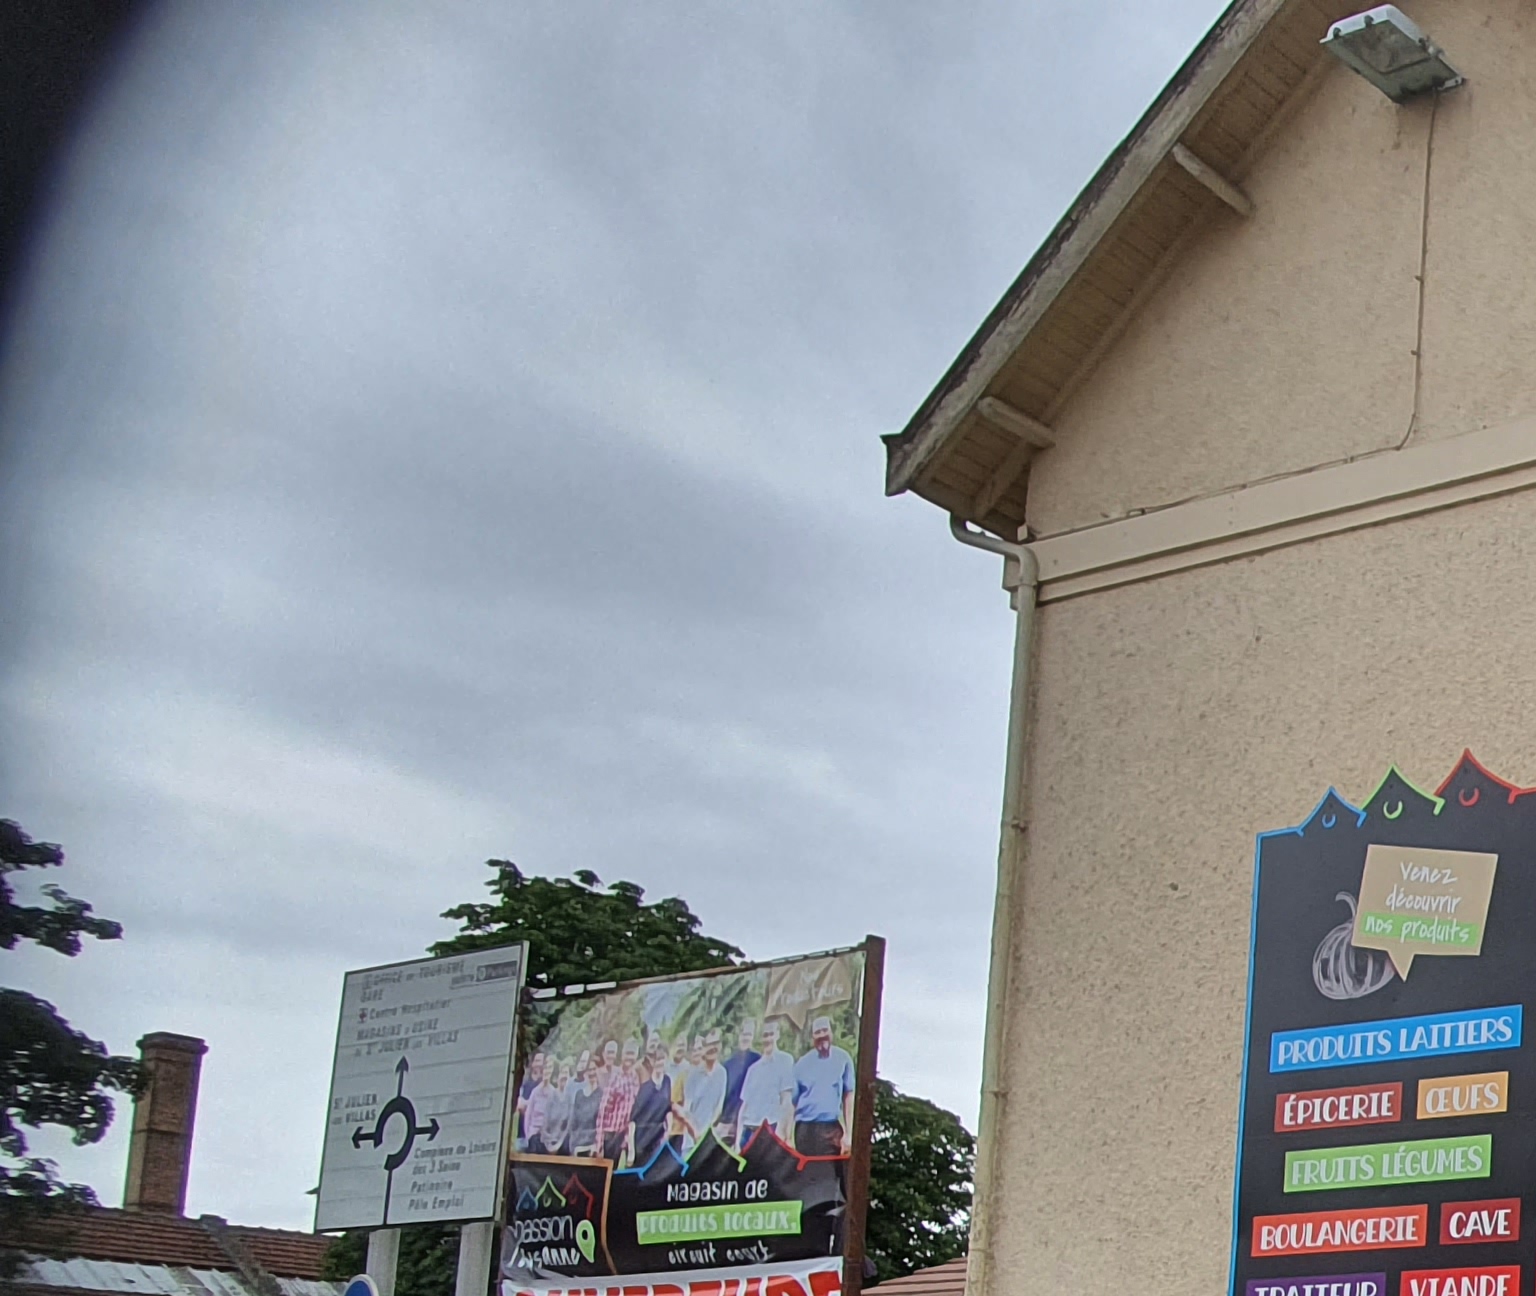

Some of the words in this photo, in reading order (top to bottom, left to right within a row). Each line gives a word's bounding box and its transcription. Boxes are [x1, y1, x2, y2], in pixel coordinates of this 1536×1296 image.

[1399, 861, 1458, 885] Venez
[1385, 887, 1462, 914] découvrir
[1365, 915, 1393, 934] nos
[1401, 918, 1470, 944] produits
[1277, 1030, 1392, 1066] PRODUITS
[1399, 1016, 1513, 1053] LAITIERS
[1282, 1089, 1395, 1126] ÉPICERIE
[1425, 1082, 1500, 1115] ŒUFS
[1290, 1154, 1375, 1186] FRUITS
[1381, 1144, 1484, 1179] LÉGUMES
[666, 1179, 739, 1204] Magasin
[744, 1178, 768, 1199] de
[637, 1210, 719, 1236] produits
[1260, 1215, 1420, 1251] BOULANGERIE
[1448, 1209, 1512, 1239] CAVE
[667, 1242, 717, 1264] circuit
[726, 1240, 773, 1264] court
